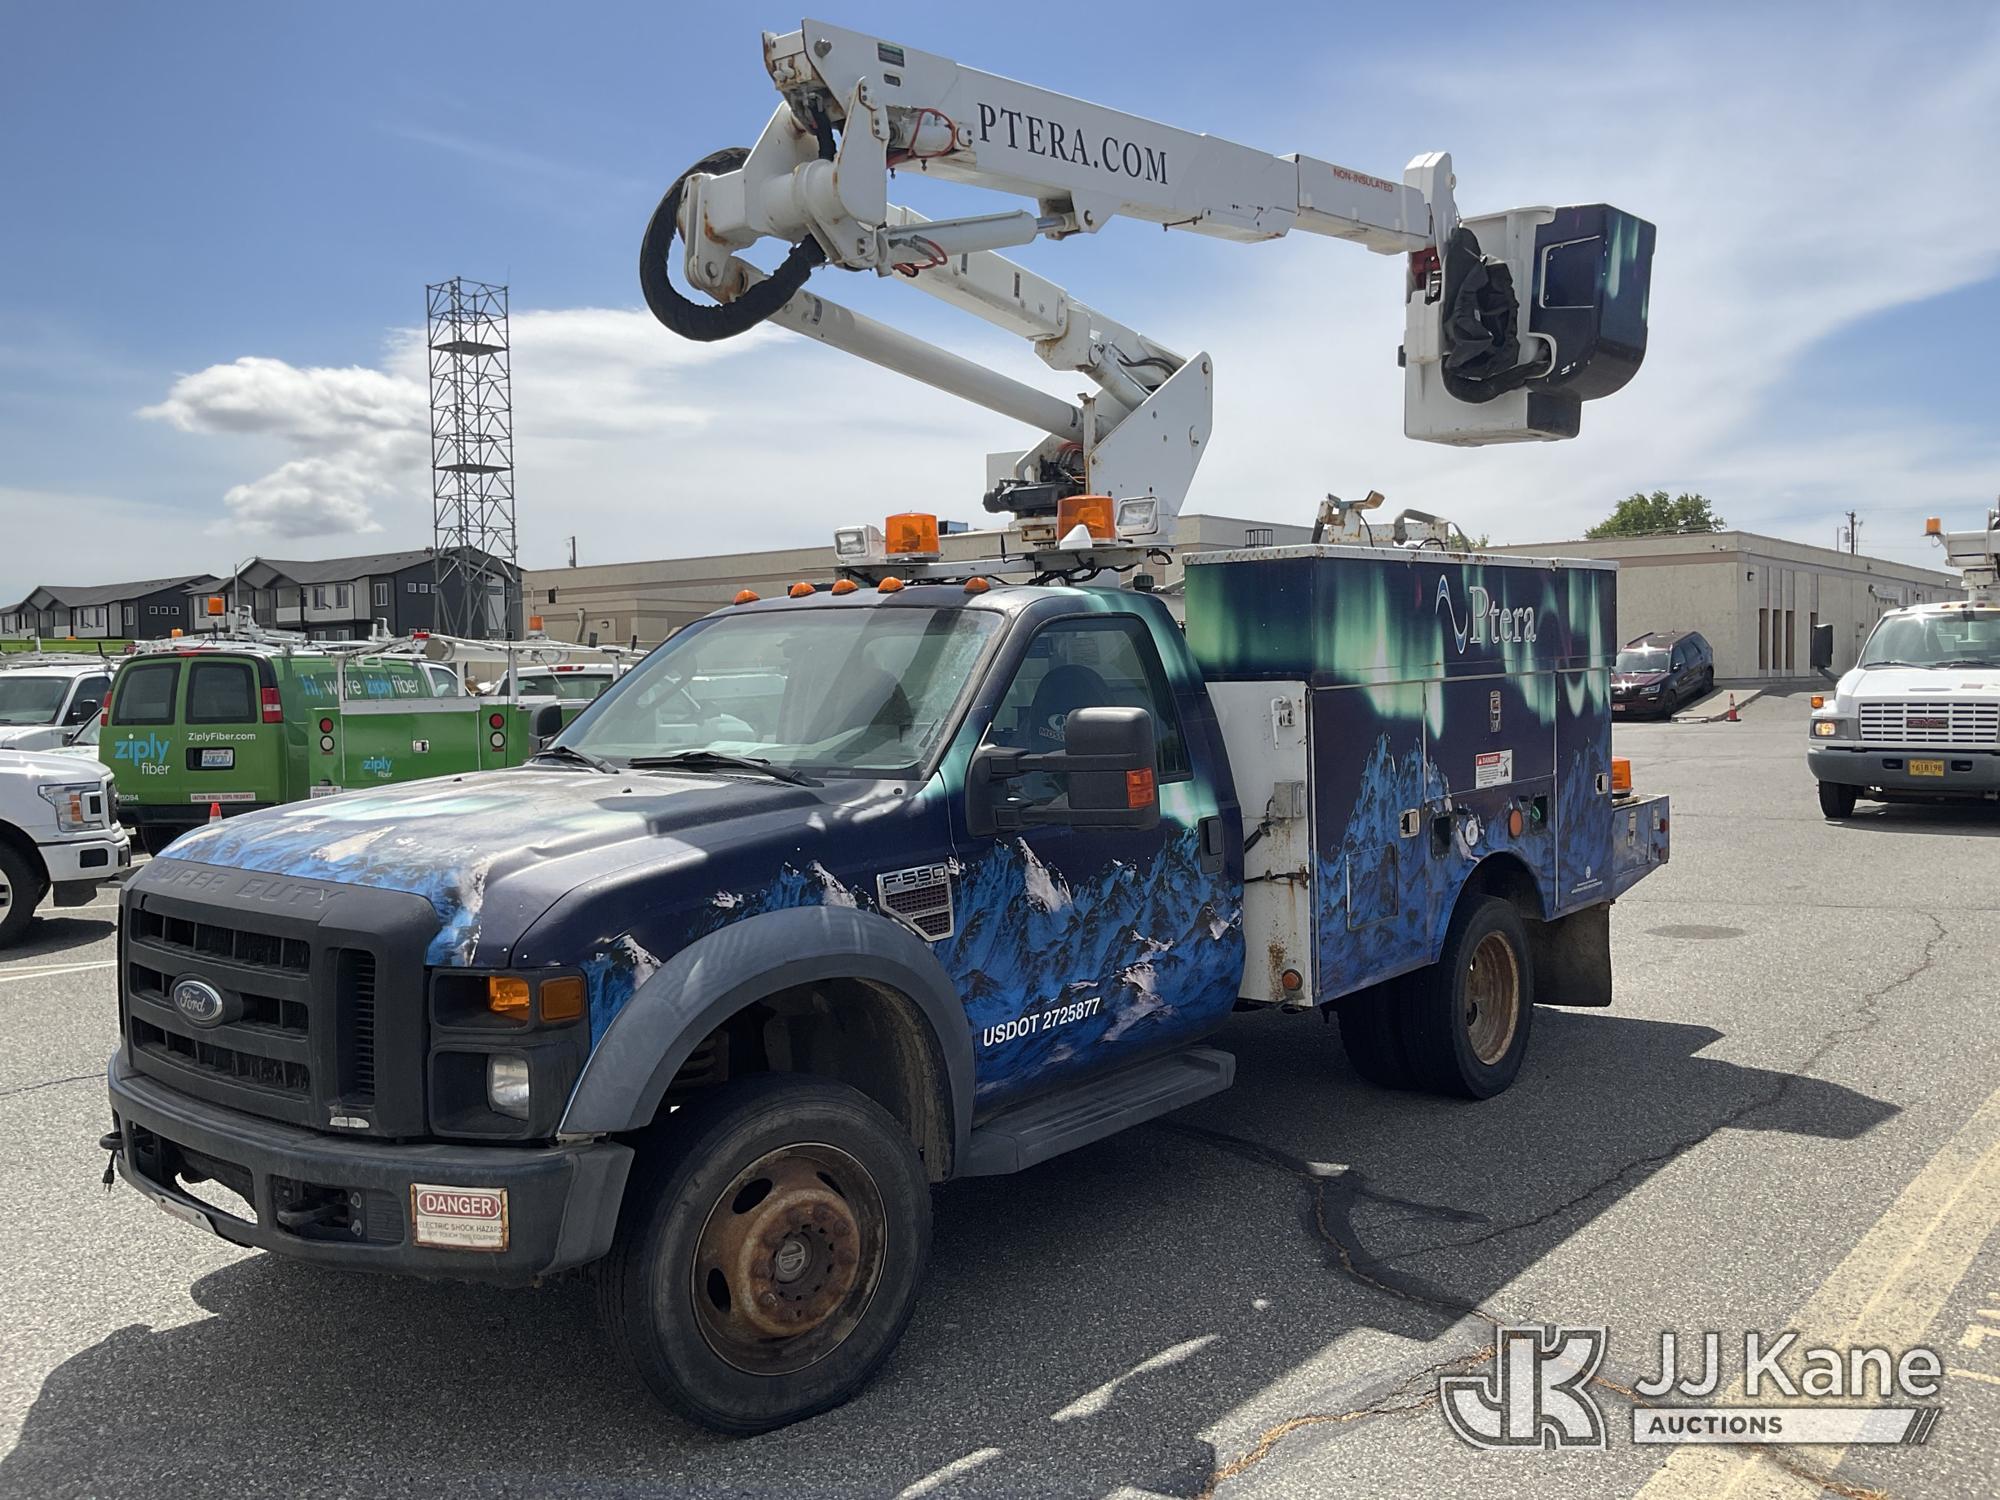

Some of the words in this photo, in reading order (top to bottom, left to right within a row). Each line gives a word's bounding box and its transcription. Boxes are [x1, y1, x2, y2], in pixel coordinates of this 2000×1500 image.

[977, 102, 1168, 185] PTERA.COM
[1333, 167, 1393, 193] NON-INSULATED
[1469, 585, 1537, 645] Ptera
[392, 674, 420, 695] fiber
[188, 732, 257, 742] ZiplyFiber.com
[115, 732, 170, 767] ziply
[141, 762, 171, 775] fiber
[363, 756, 392, 773] ziply
[377, 770, 393, 778] fiber
[235, 877, 346, 909] DUTY
[179, 988, 206, 1013] Ford
[983, 1013, 1040, 1047] USDOT
[1042, 997, 1101, 1031] 2725877
[426, 1194, 492, 1215] DANGER
[451, 1223, 474, 1233] SHOCK
